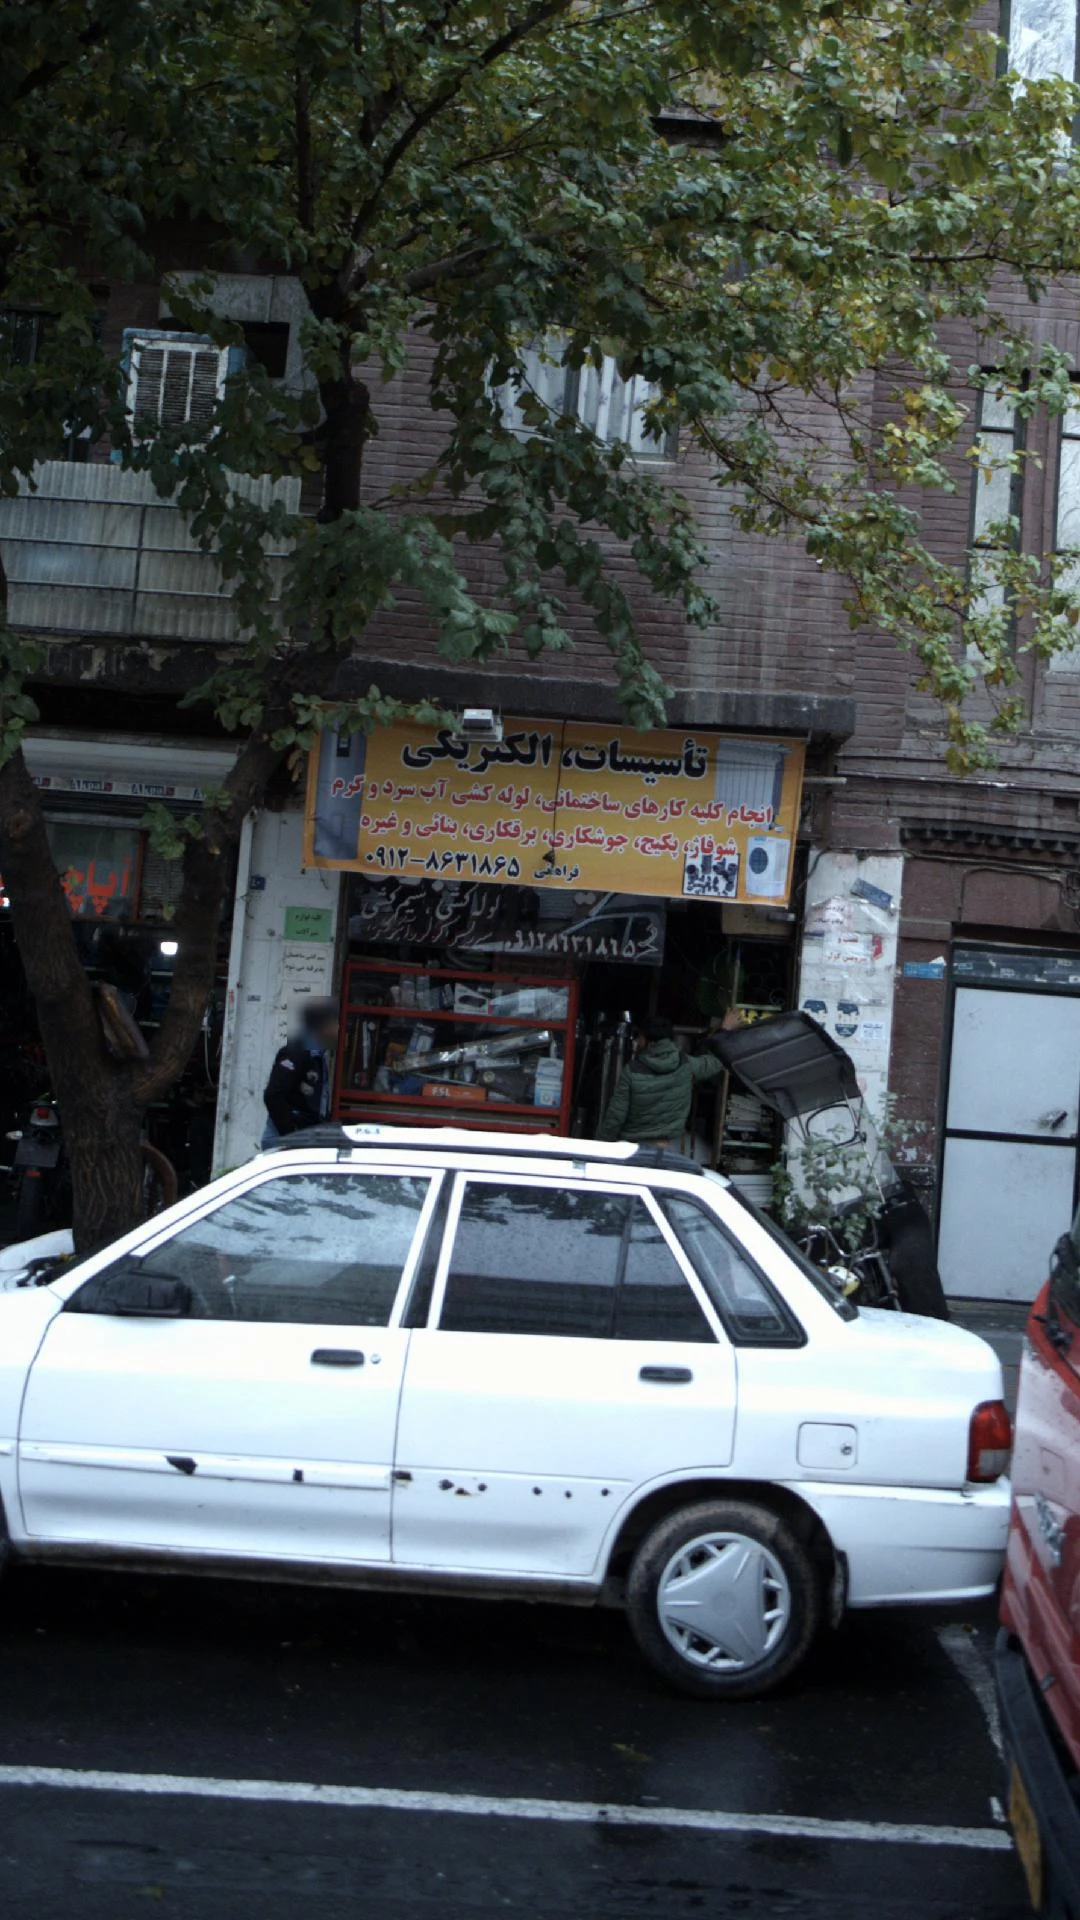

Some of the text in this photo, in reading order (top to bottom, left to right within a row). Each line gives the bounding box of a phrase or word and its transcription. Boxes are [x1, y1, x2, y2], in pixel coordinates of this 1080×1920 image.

[562, 738, 708, 783] تأسیسات،
[331, 774, 364, 798] گرم
[368, 781, 378, 800] و
[383, 780, 415, 802] سرد
[420, 779, 447, 803] آب
[452, 783, 493, 806] کشی
[497, 786, 530, 810] لوله
[361, 811, 396, 835] غیره
[690, 803, 723, 824] کلیه
[728, 806, 772, 827] انجام
[402, 818, 411, 836] و
